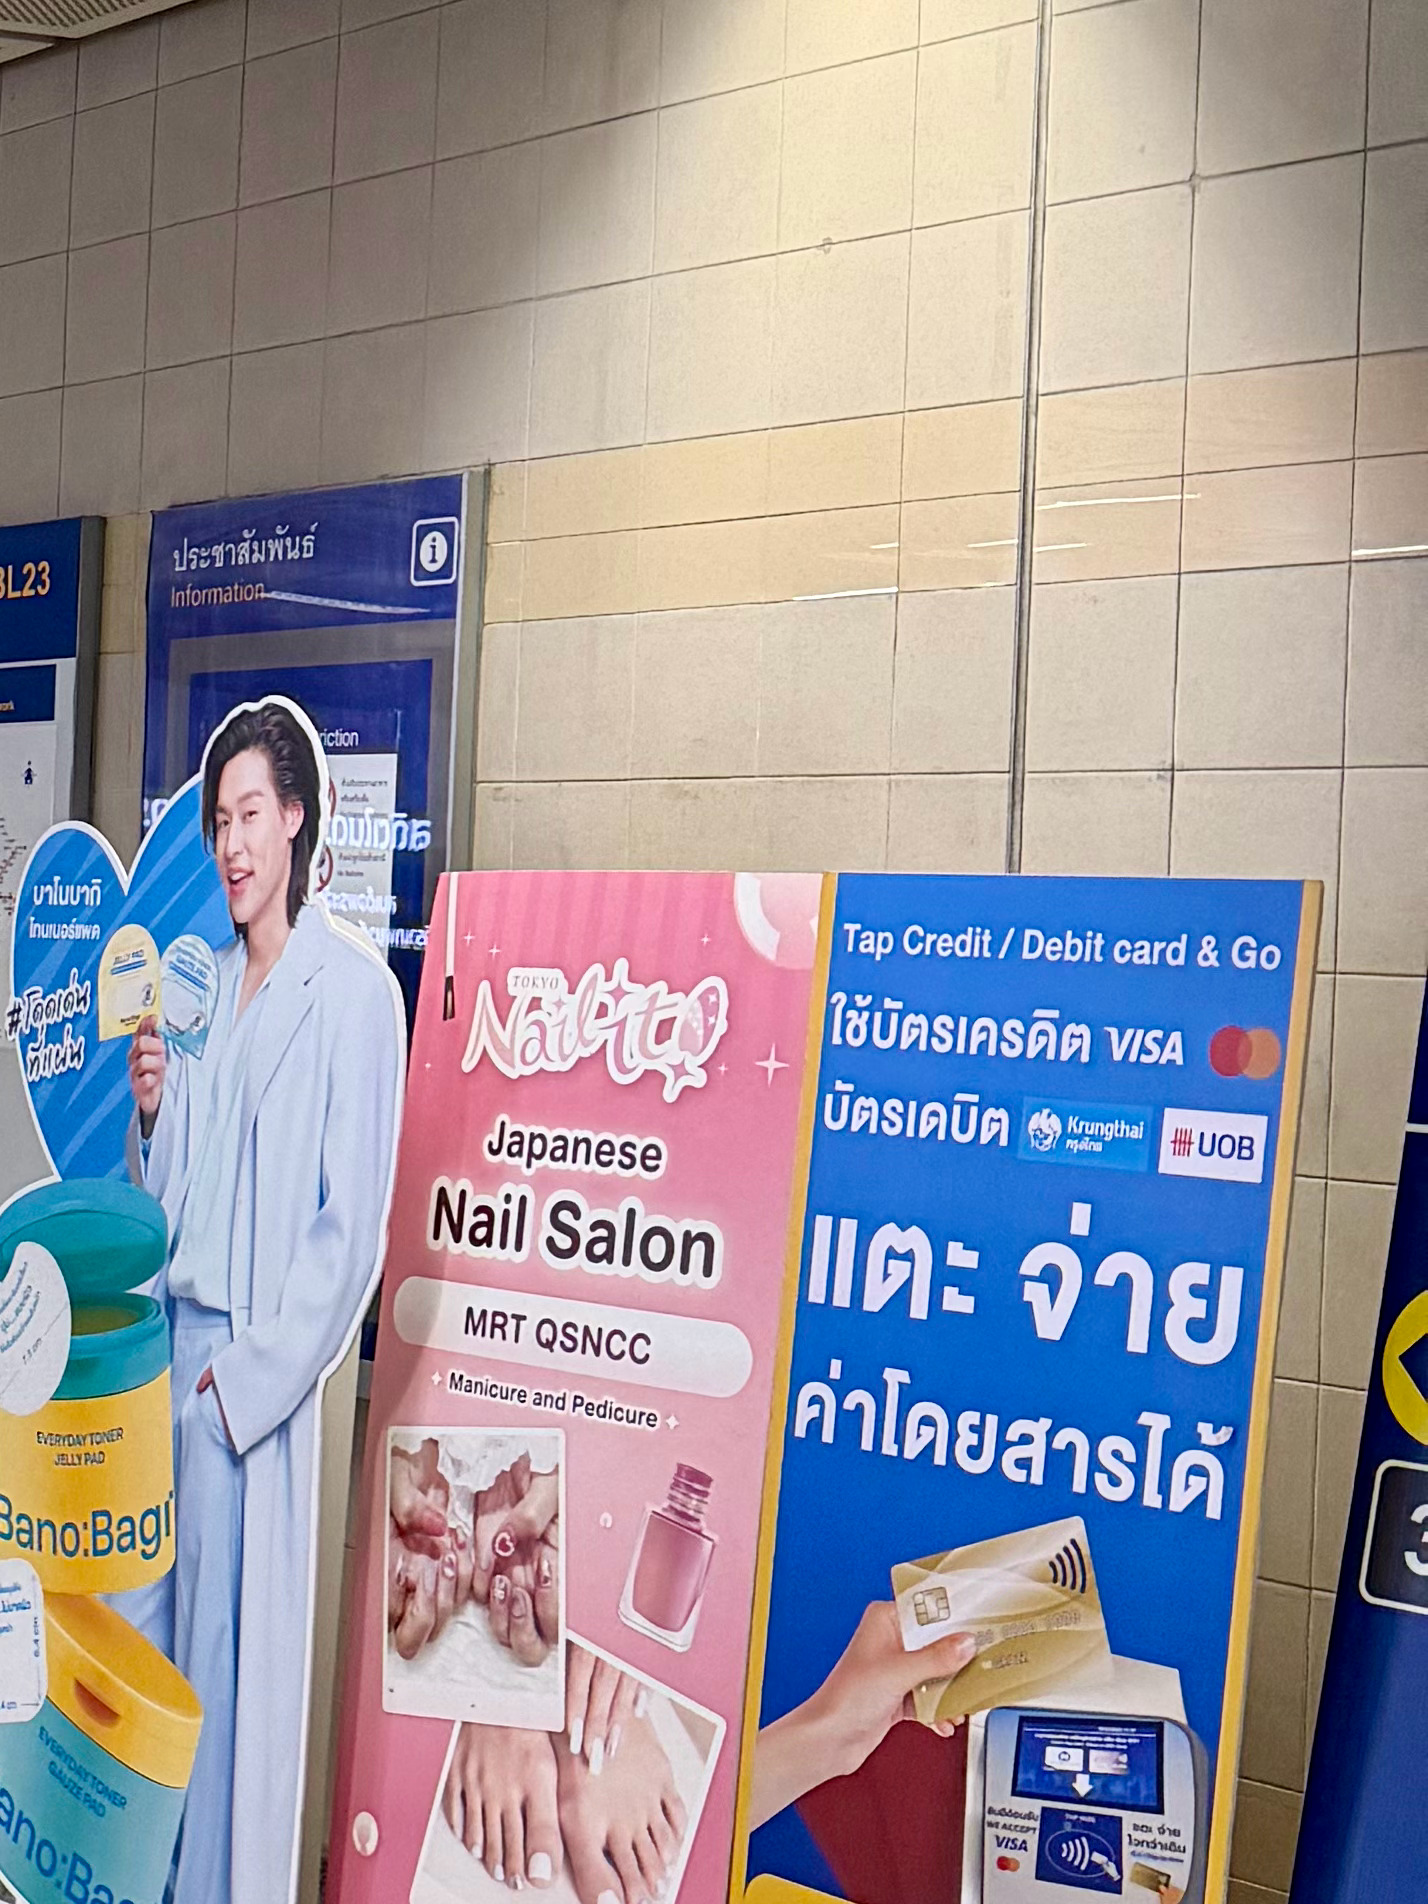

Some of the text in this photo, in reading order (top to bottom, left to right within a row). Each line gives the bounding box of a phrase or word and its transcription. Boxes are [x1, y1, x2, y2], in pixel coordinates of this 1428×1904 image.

[173, 522, 319, 573] ประชาสัมพันธ์
[170, 581, 266, 608] Information
[319, 728, 359, 747] riction
[33, 876, 102, 906] บาโนบากิ
[29, 917, 101, 940] โทนเนอร์แพด
[843, 923, 1282, 971] Tap Credit / Debit card & Go
[512, 975, 559, 991] TOKYO
[830, 991, 1091, 1064] ใช้บัตรเครดิต
[1104, 1026, 1185, 1066] VISA
[823, 1079, 1010, 1148] บัตรเดบิต
[1067, 1115, 1145, 1142] Krungthai
[487, 1120, 663, 1173] Japanese
[1198, 1131, 1255, 1160] UOB
[432, 1185, 716, 1279] Nail Salon
[807, 1201, 1244, 1366] แตะ จ่าย
[464, 1306, 652, 1365] MRT QSNCC
[449, 1371, 659, 1428] Manicure and Pedicure
[36, 1427, 124, 1447] EVERYDAY TONER
[793, 1357, 1235, 1521] ค่าโดยสารได้
[54, 1451, 106, 1466] JELLY PAD
[83, 1792, 106, 1818] PAD
[88, 1771, 128, 1809] TONER
[986, 1820, 1037, 1835] WE ACCEPT
[994, 1834, 1029, 1853] VISA
